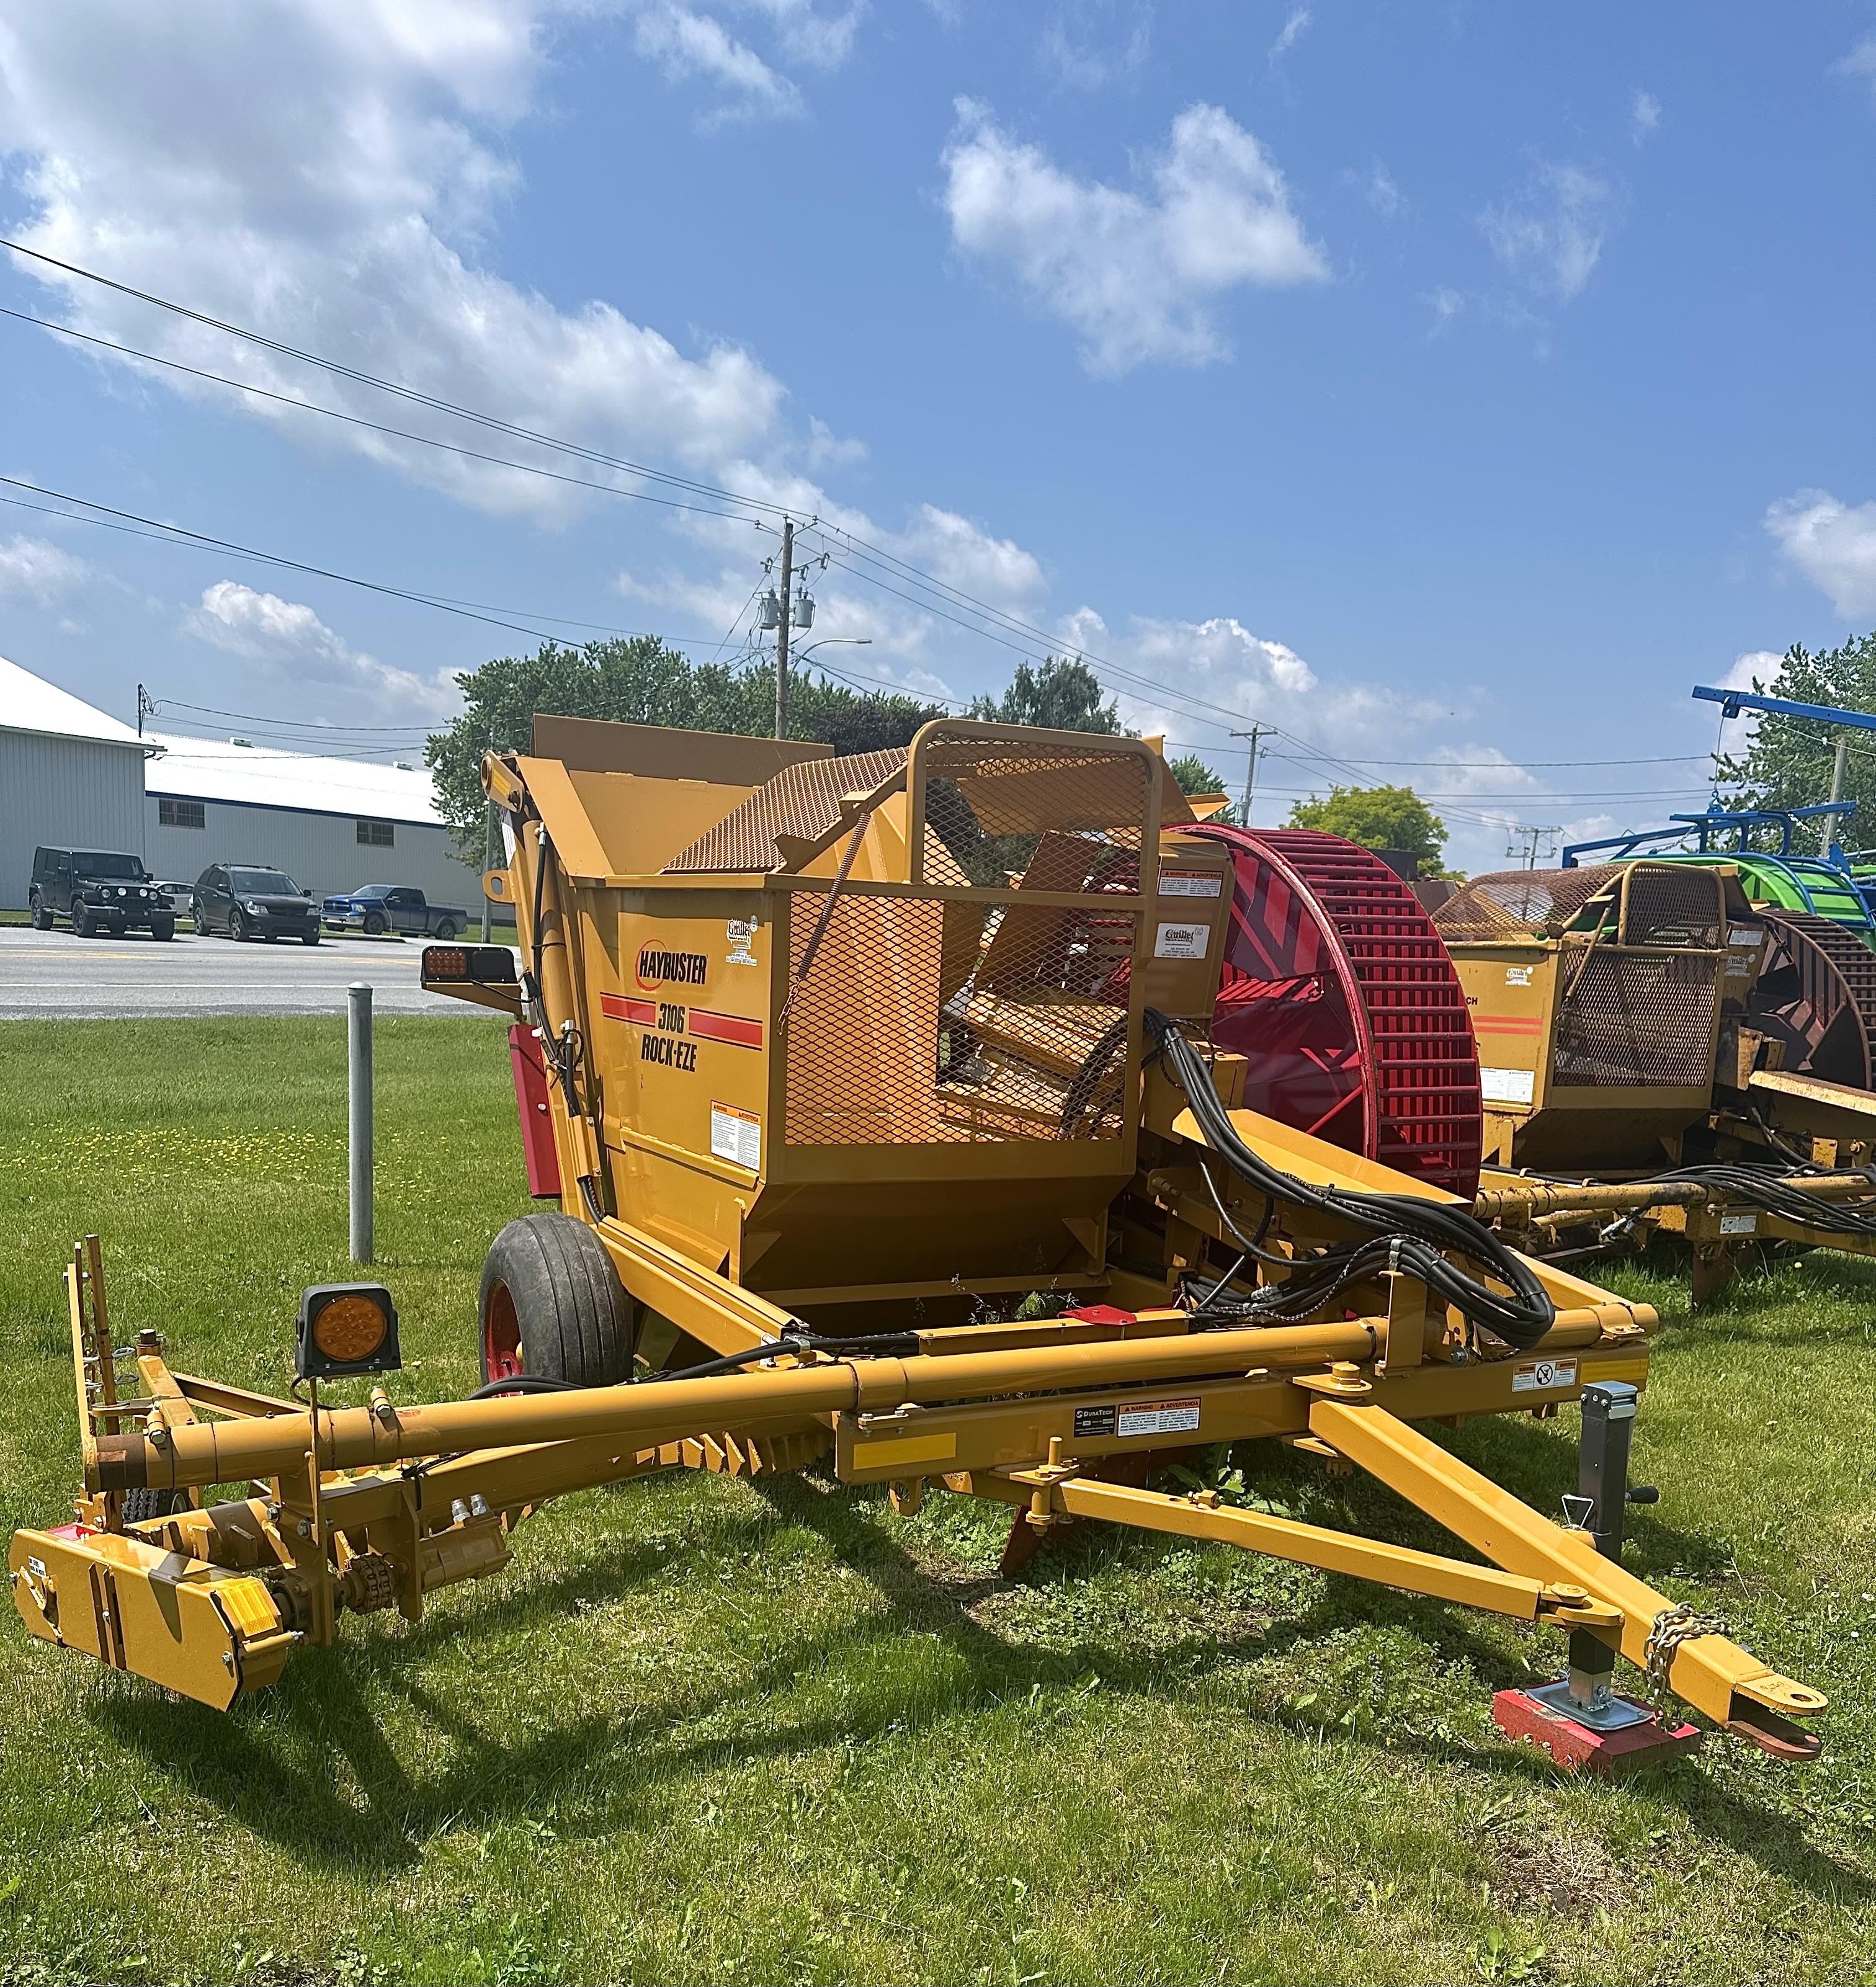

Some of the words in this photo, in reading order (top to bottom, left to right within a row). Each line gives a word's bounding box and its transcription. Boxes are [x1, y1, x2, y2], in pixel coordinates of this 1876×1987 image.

[639, 950, 707, 985] HAYBUSTER
[658, 1002, 686, 1034] 3106
[641, 1034, 697, 1073] ROCK-EZE
